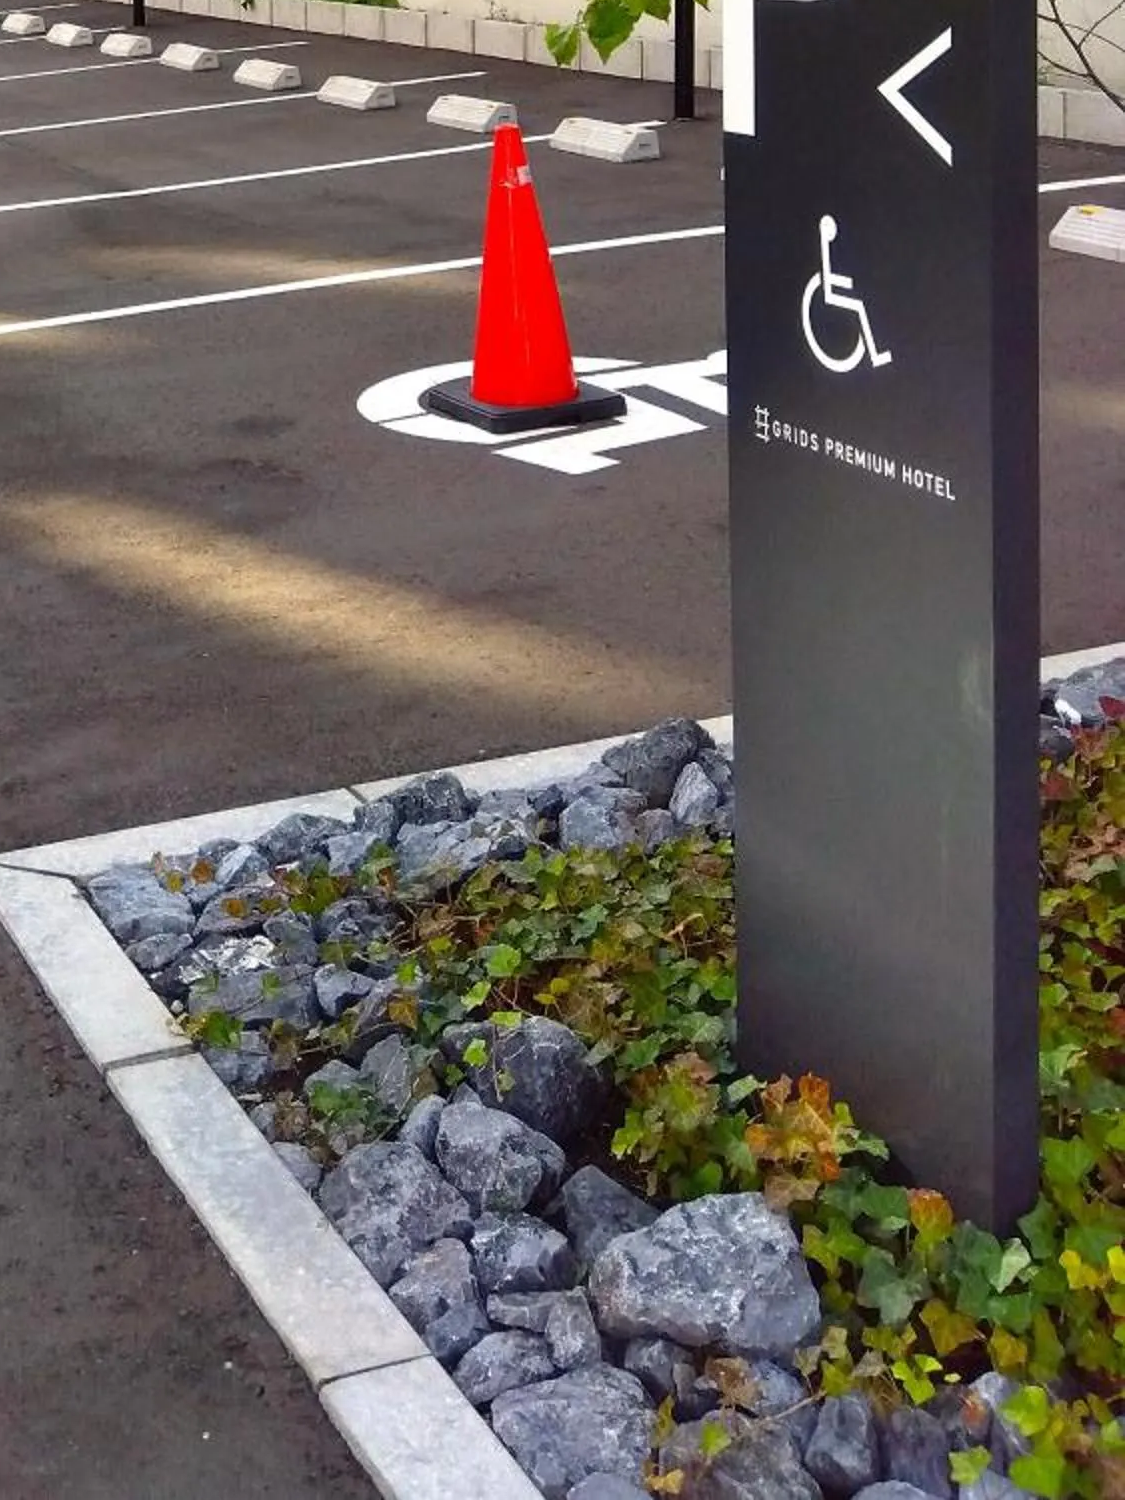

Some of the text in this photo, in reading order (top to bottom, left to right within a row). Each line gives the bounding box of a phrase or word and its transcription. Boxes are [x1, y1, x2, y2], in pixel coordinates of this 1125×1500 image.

[772, 420, 956, 501] GRIDS PREMIUM HOTEL
